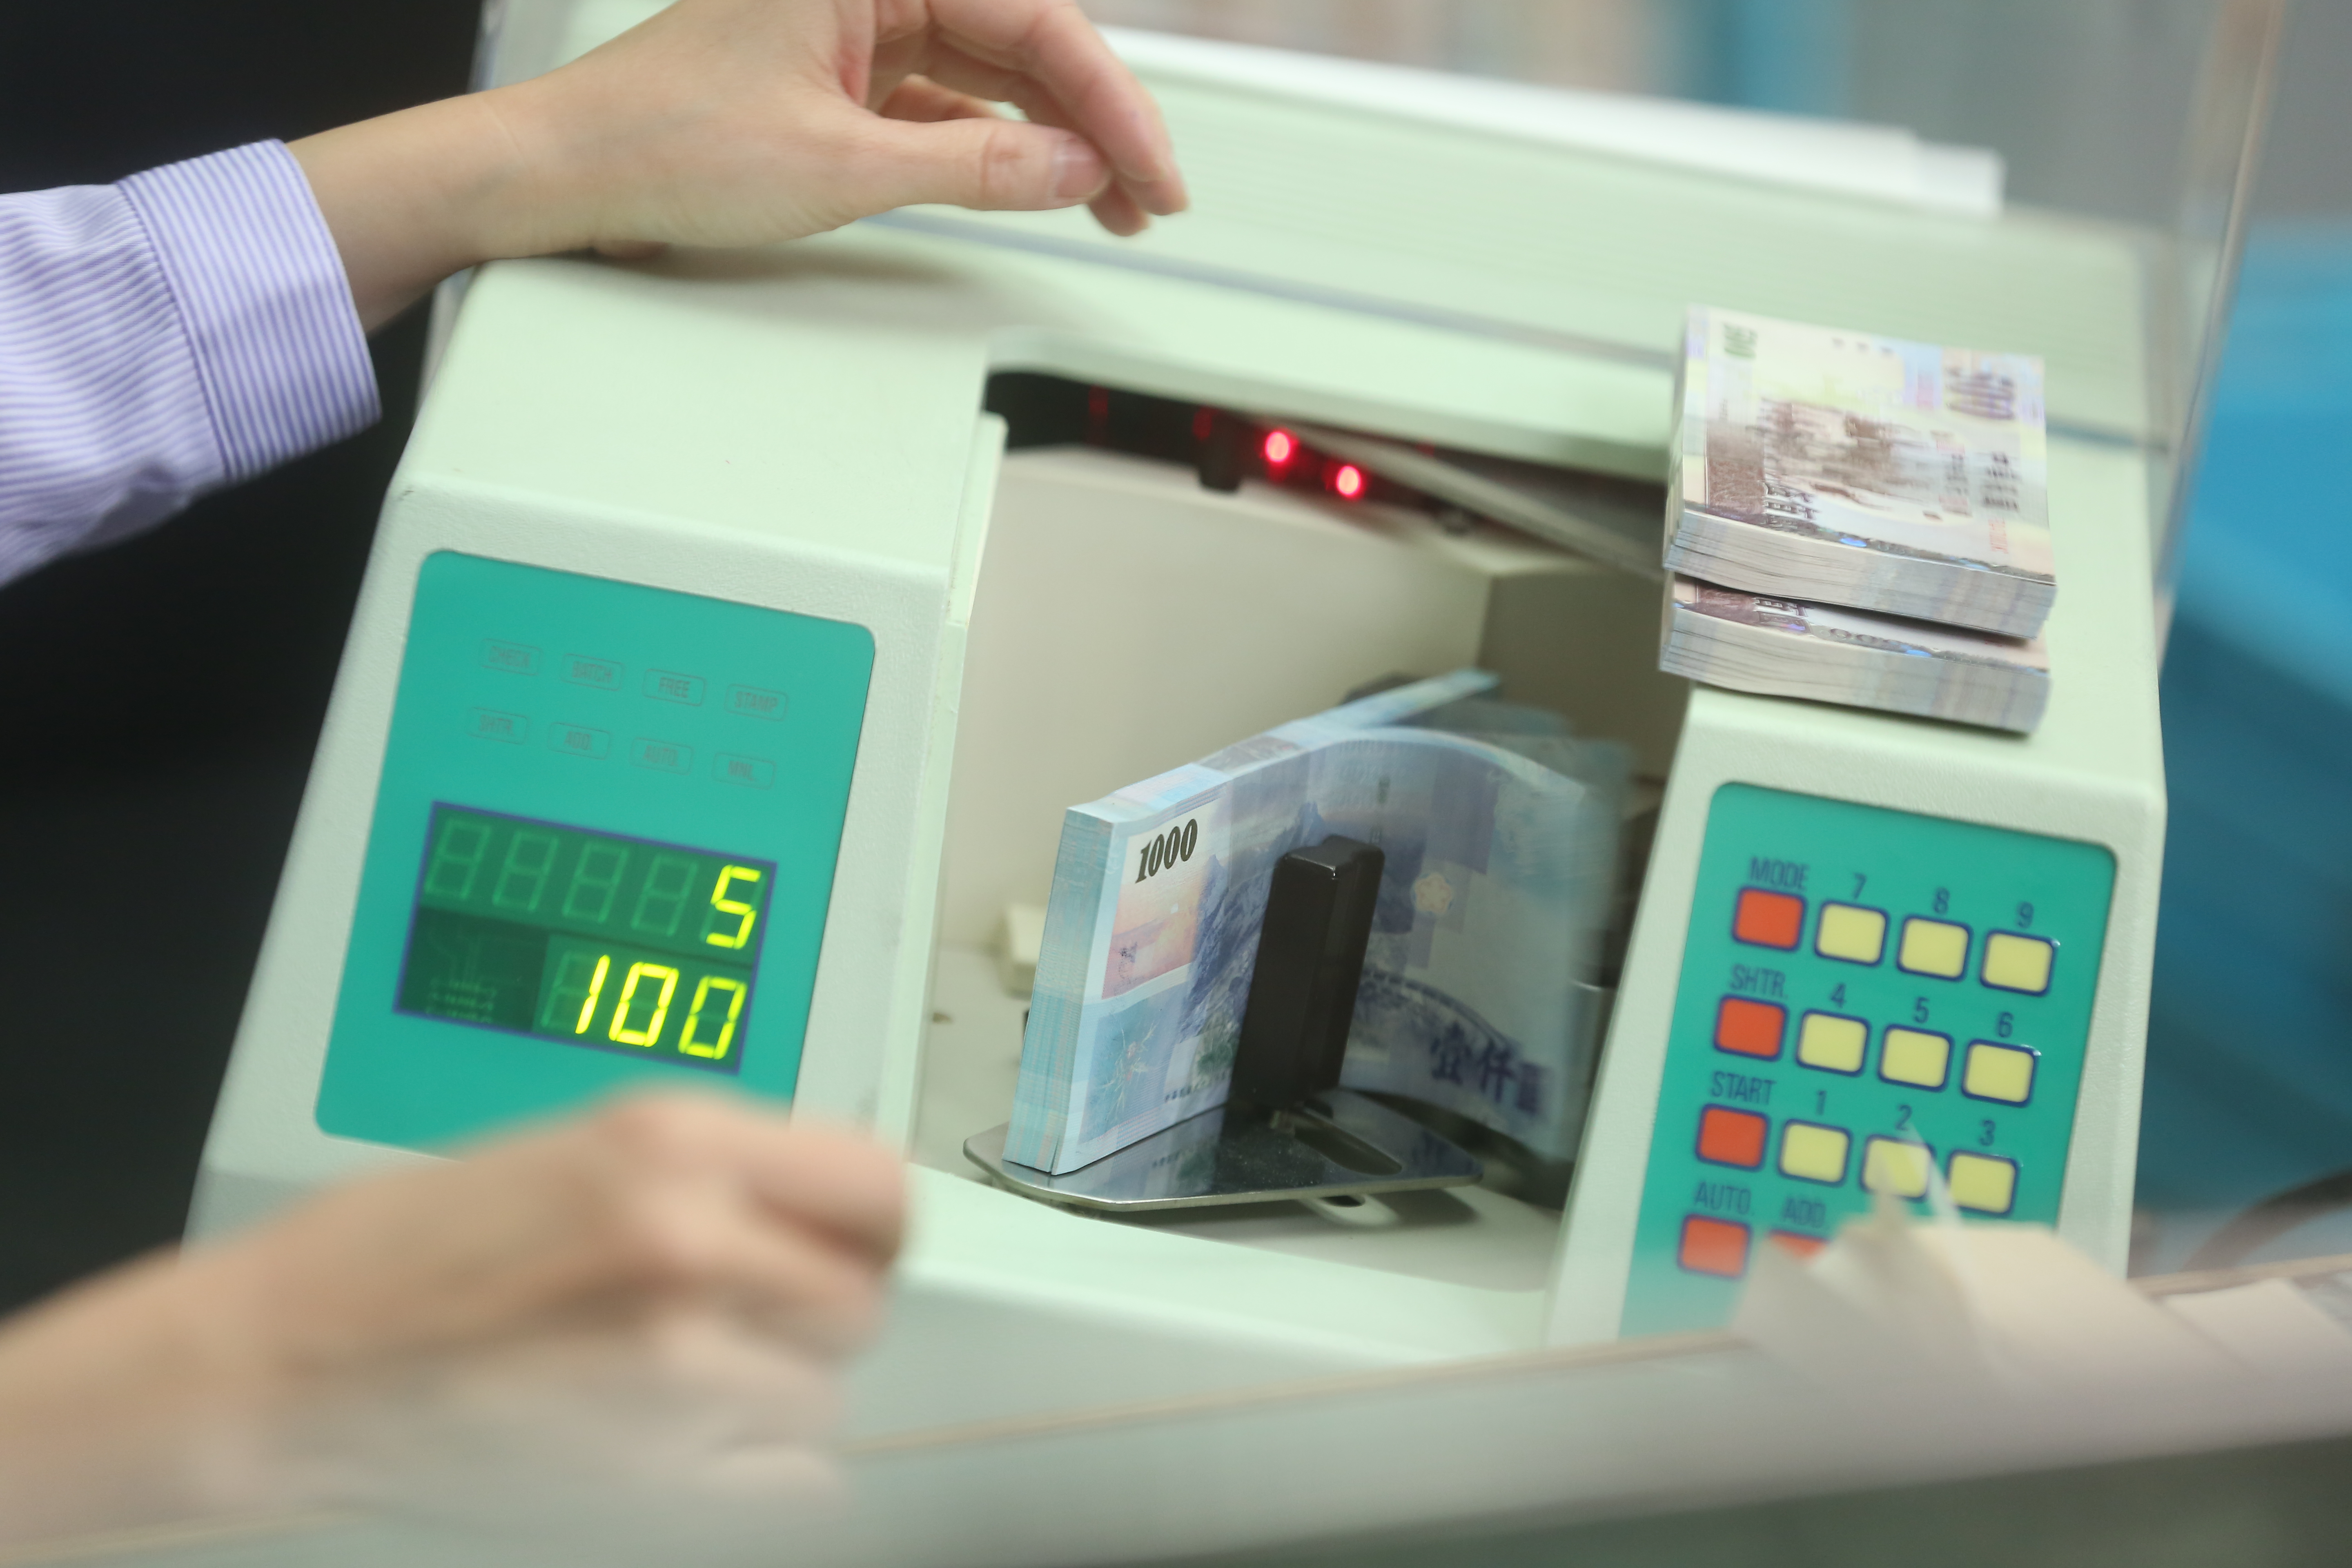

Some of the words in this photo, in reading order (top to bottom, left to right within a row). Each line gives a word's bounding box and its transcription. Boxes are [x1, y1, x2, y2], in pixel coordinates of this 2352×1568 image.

[572, 660, 612, 683] BATCH
[659, 676, 691, 699] FREE
[735, 691, 779, 713] STAMP
[1135, 818, 1198, 884] 1000
[1749, 856, 1809, 890] MODE
[1853, 872, 1866, 898] 7
[710, 864, 762, 949] 5
[1933, 887, 1951, 915] 8
[2016, 902, 2034, 929] 9
[575, 954, 747, 1059] 100
[1831, 984, 1846, 1009] 4
[1913, 997, 1930, 1024] 5
[1996, 1011, 2013, 1038] 6
[1711, 1071, 1776, 1105] START
[1815, 1090, 1828, 1116] 1
[1895, 1104, 1913, 1131] 2
[1978, 1119, 1996, 1146] 3
